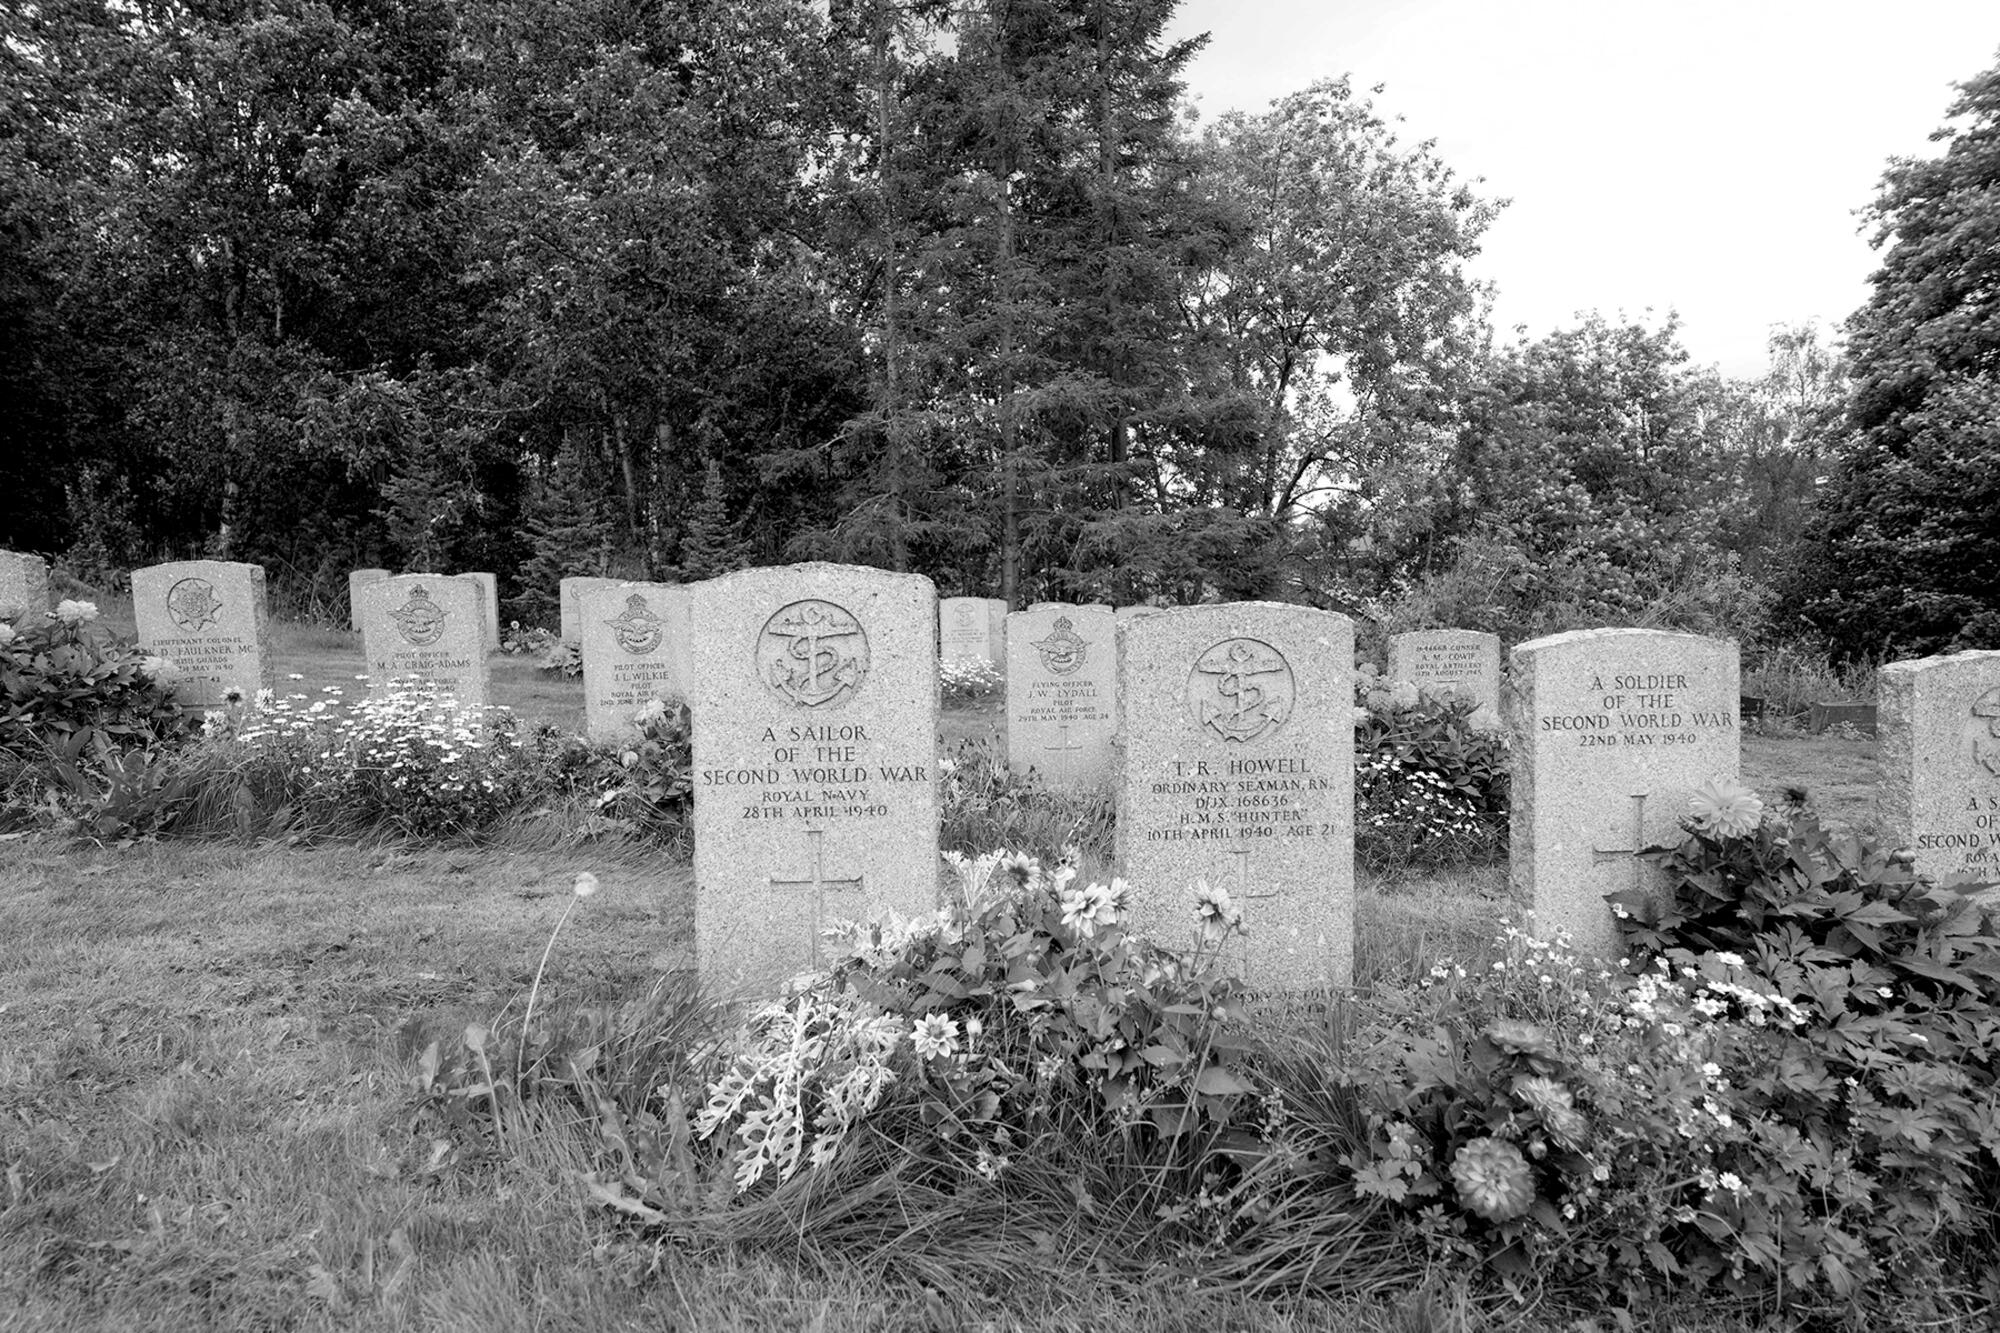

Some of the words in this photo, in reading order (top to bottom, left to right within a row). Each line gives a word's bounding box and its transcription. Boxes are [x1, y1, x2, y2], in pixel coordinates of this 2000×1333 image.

[152, 638, 203, 646] LIEUTENANT
[177, 646, 232, 656] FAULKNER
[238, 644, 253, 654] MC
[1448, 652, 1475, 661] COWIE
[404, 658, 471, 670] CRAIG-ADAMS
[632, 671, 669, 680] WILKIE
[1591, 677, 1604, 690] A
[1615, 675, 1688, 689] SOLDIER
[1057, 689, 1098, 698] LYDALL
[1603, 695, 1626, 709] OF
[1637, 694, 1674, 709] THE
[1542, 715, 1610, 731] SECOND
[1621, 713, 1683, 729] WORLD
[1692, 712, 1734, 728] WAR
[762, 727, 777, 742] A
[1580, 735, 1616, 747] 22ND
[1623, 734, 1656, 745] MAY
[1663, 733, 1697, 744] 1940
[775, 748, 800, 762] OF
[816, 746, 856, 762] THE
[1230, 759, 1311, 775] HOWELL
[703, 769, 780, 785] SECOND
[793, 767, 868, 783] WORLD
[880, 766, 929, 782] WAR
[1152, 781, 1229, 794] ORDINARY
[762, 791, 814, 802] ROYAL
[822, 789, 870, 801] NAVY
[1237, 795, 1288, 807] 168636
[1966, 797, 1978, 811] A
[742, 806, 783, 819] 28TH
[792, 805, 837, 818] APRIL
[847, 804, 888, 816] 1940
[1976, 815, 1998, 829] OF
[1148, 829, 1182, 841] 10TH
[1191, 828, 1231, 840] APRIL
[1239, 826, 1272, 839] 1940
[1286, 826, 1313, 837] AGE
[1321, 823, 1335, 836] 21
[1917, 833, 1980, 850] SECOND
[1966, 853, 1999, 863] ROYA
